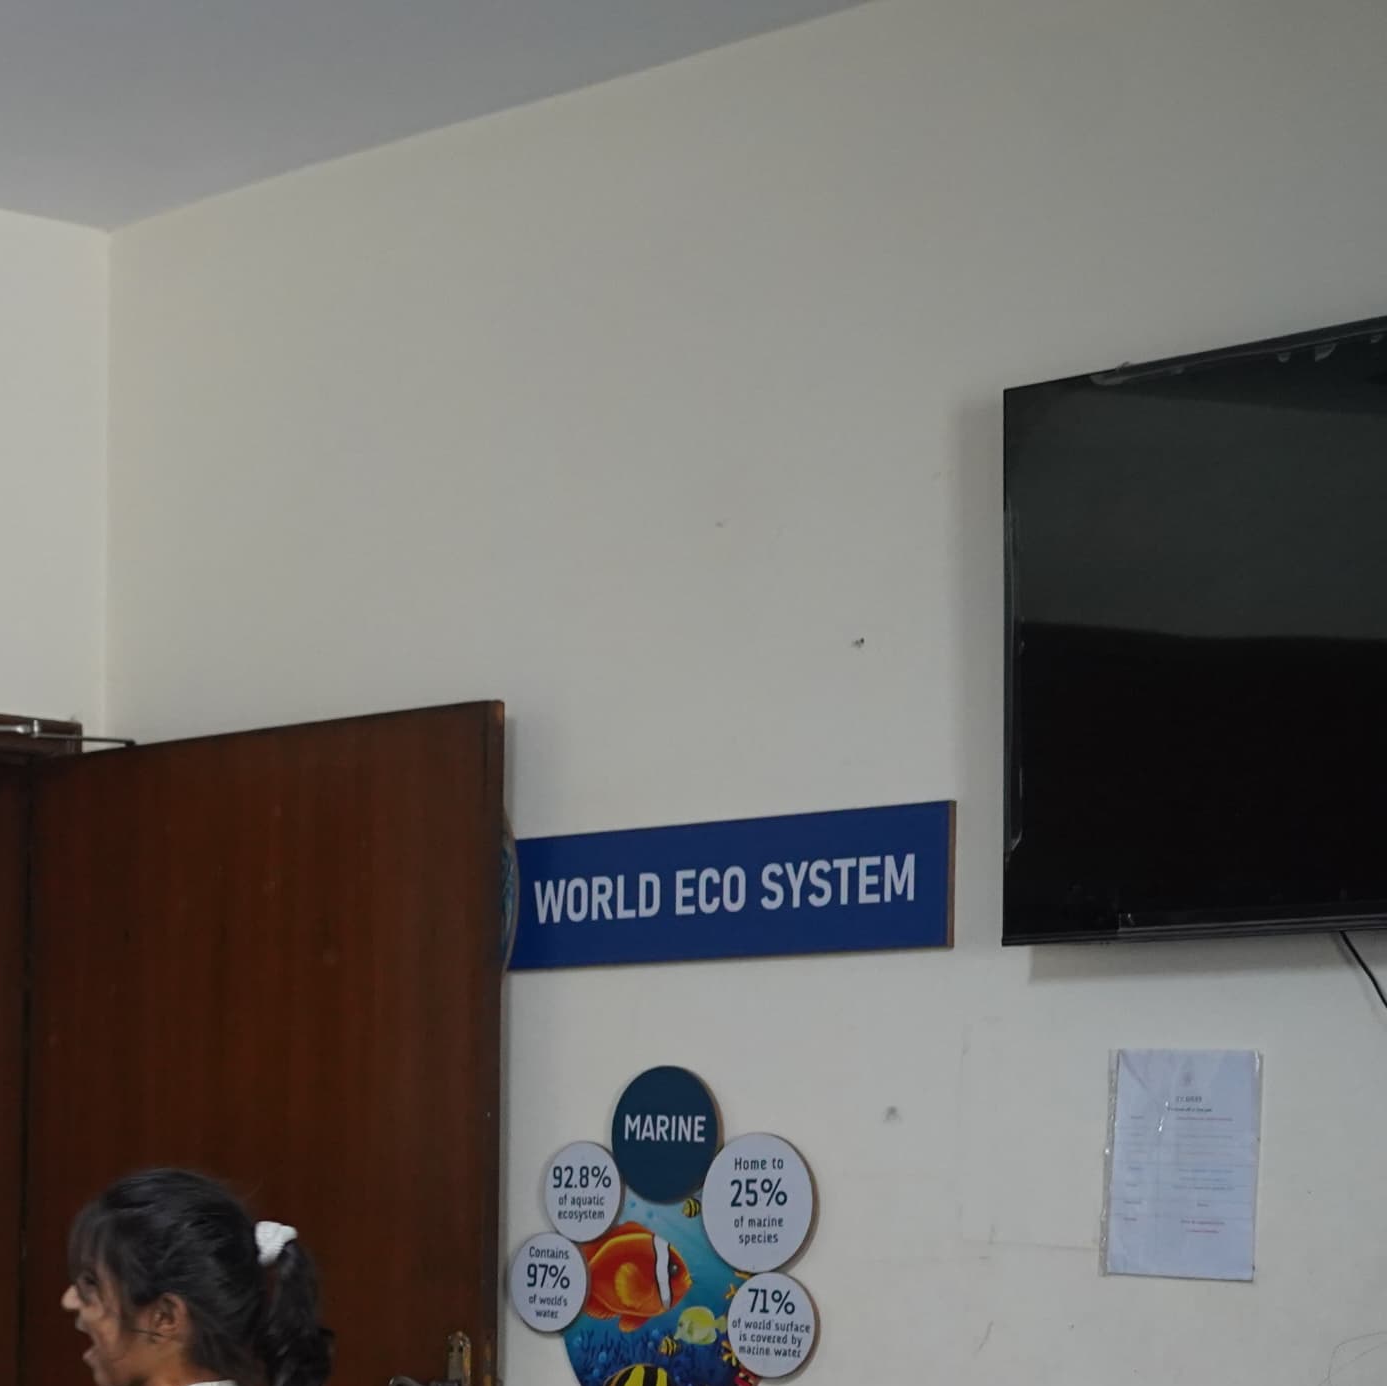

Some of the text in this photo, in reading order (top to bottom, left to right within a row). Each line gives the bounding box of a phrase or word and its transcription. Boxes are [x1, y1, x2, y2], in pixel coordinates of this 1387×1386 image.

[534, 853, 916, 924] WORLD ECO SYSTEM
[624, 1114, 707, 1143] MARINE
[734, 1157, 785, 1171] Home to
[552, 1165, 612, 1189] 92.8%
[730, 1178, 788, 1207] 25%
[558, 1194, 605, 1209] of aquatic
[557, 1209, 605, 1223] ecosystem
[733, 1216, 784, 1229] of marine
[738, 1231, 779, 1246] species
[529, 1246, 570, 1260] Contains
[526, 1263, 571, 1289] 97%
[528, 1294, 538, 1305] of
[747, 1288, 796, 1315] 71%
[535, 1310, 559, 1319] water
[732, 1318, 811, 1334] of world surface
[739, 1331, 803, 1349] is covered by
[738, 1345, 802, 1359] marine water
